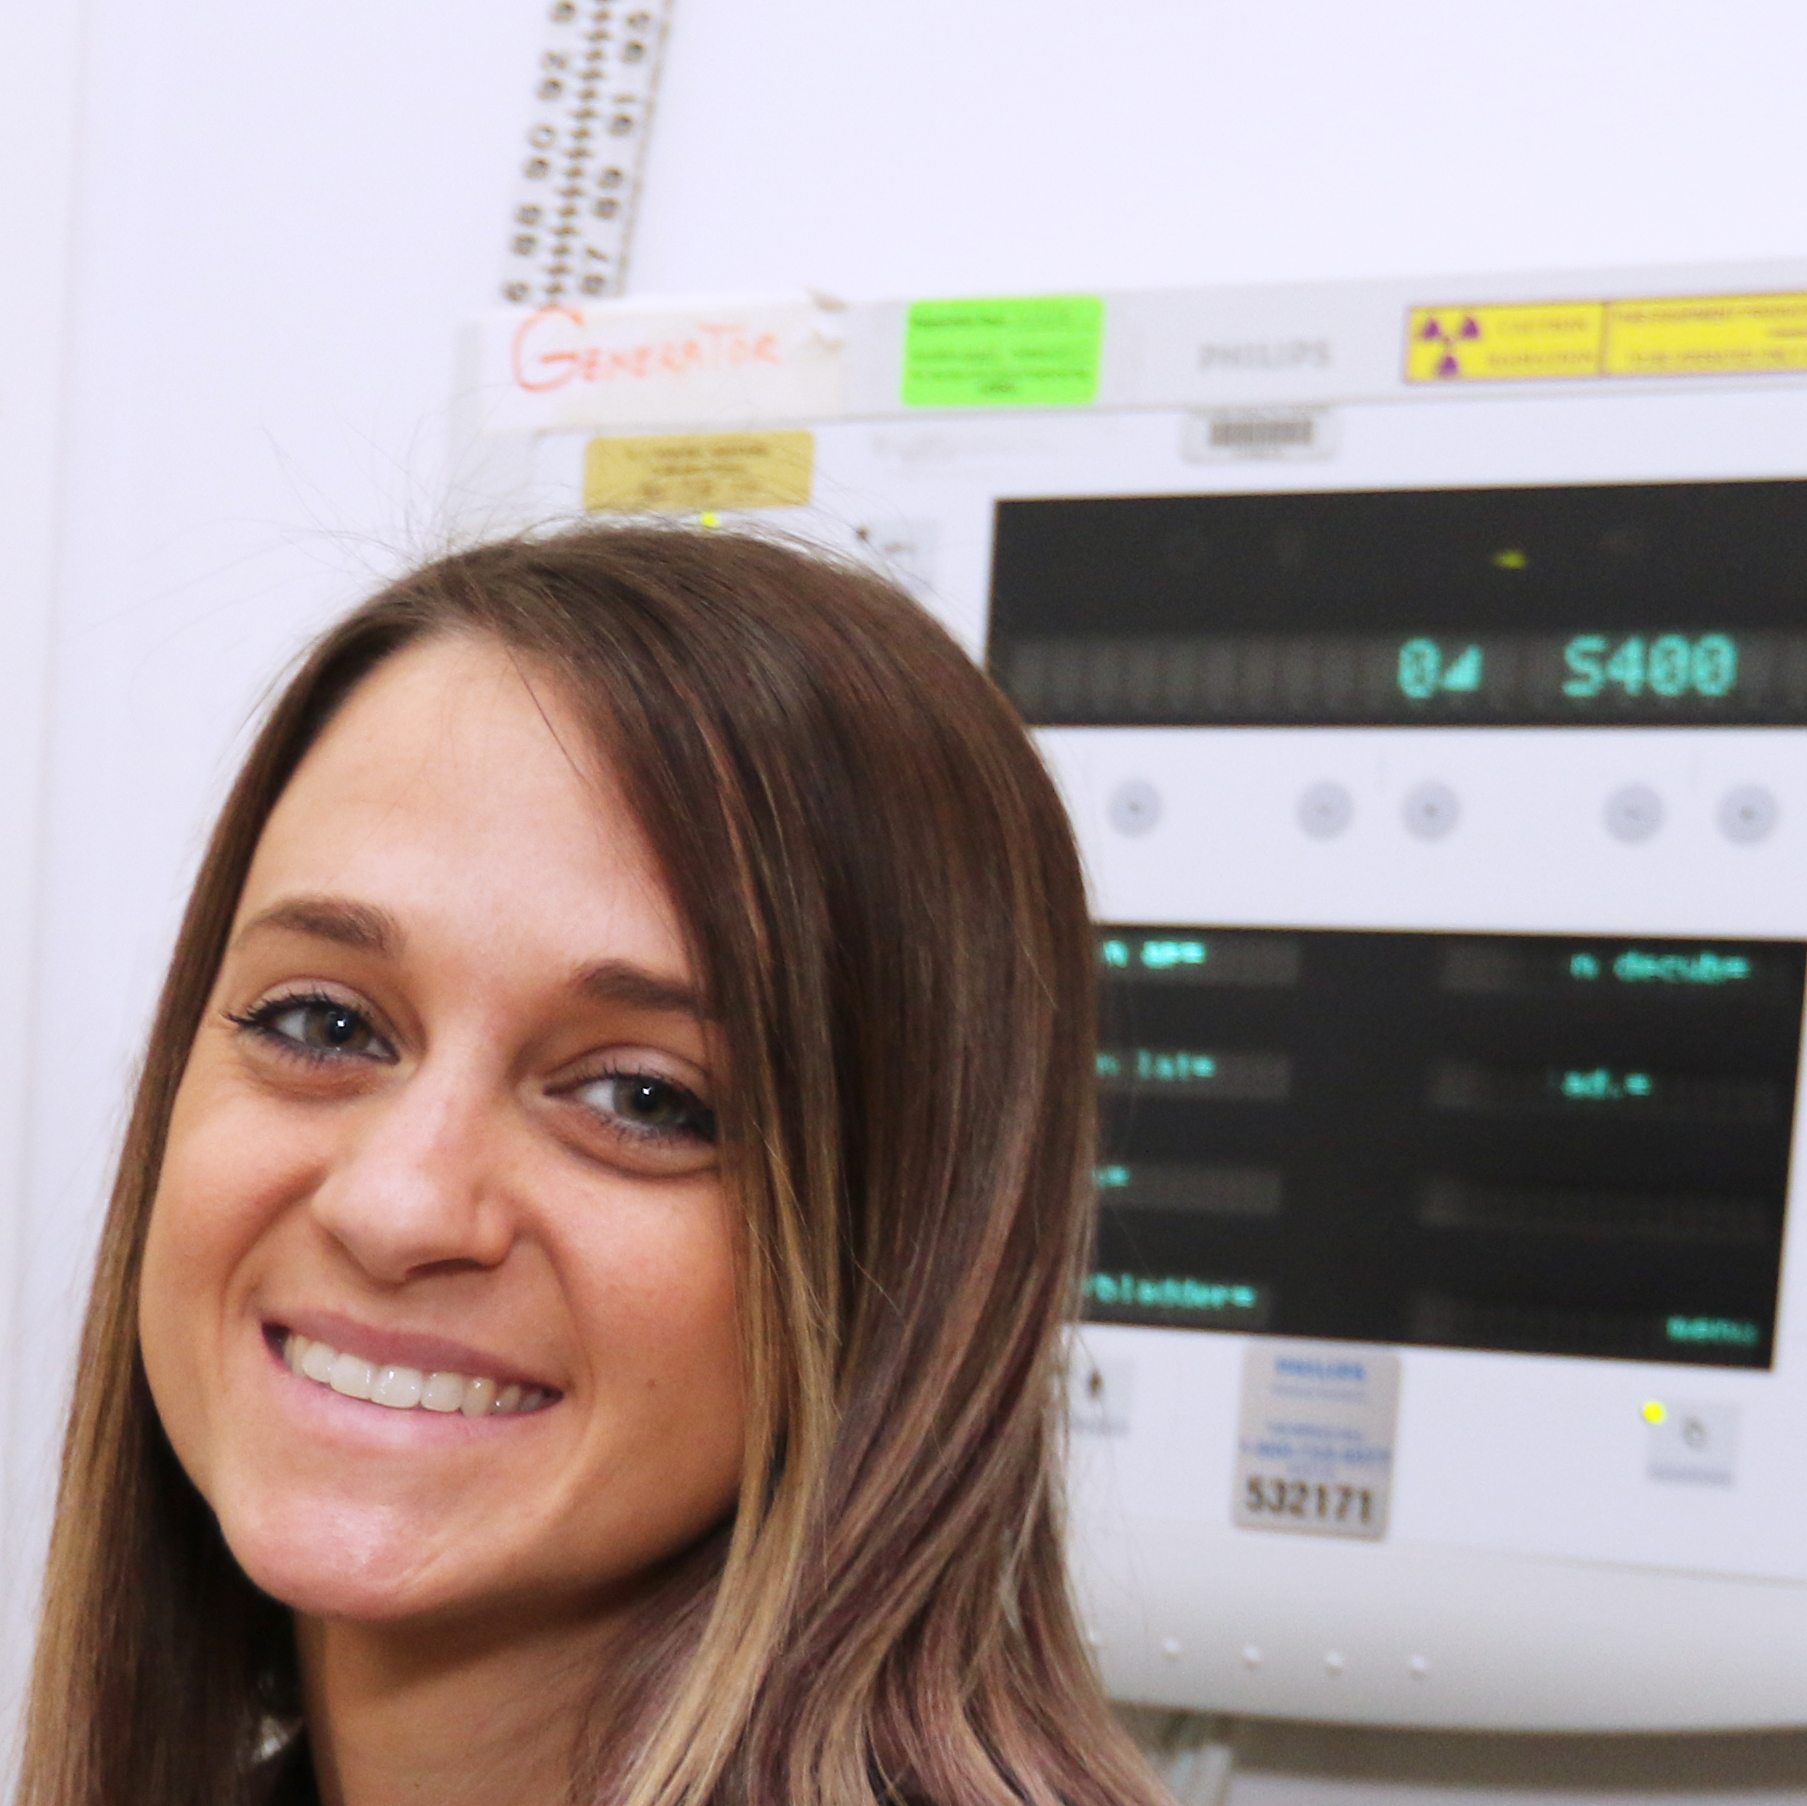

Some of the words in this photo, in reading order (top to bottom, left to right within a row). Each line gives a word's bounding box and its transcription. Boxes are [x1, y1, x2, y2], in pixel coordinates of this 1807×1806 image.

[549, 0, 577, 23] 9
[620, 11, 653, 63] 93
[538, 50, 570, 101] 92
[607, 94, 638, 137] 91
[523, 124, 557, 180] 90
[592, 165, 624, 219] 89
[512, 203, 545, 256] 88
[580, 246, 608, 295] 87
[1561, 633, 1738, 697] S400
[1247, 1475, 1373, 1524] 532171
